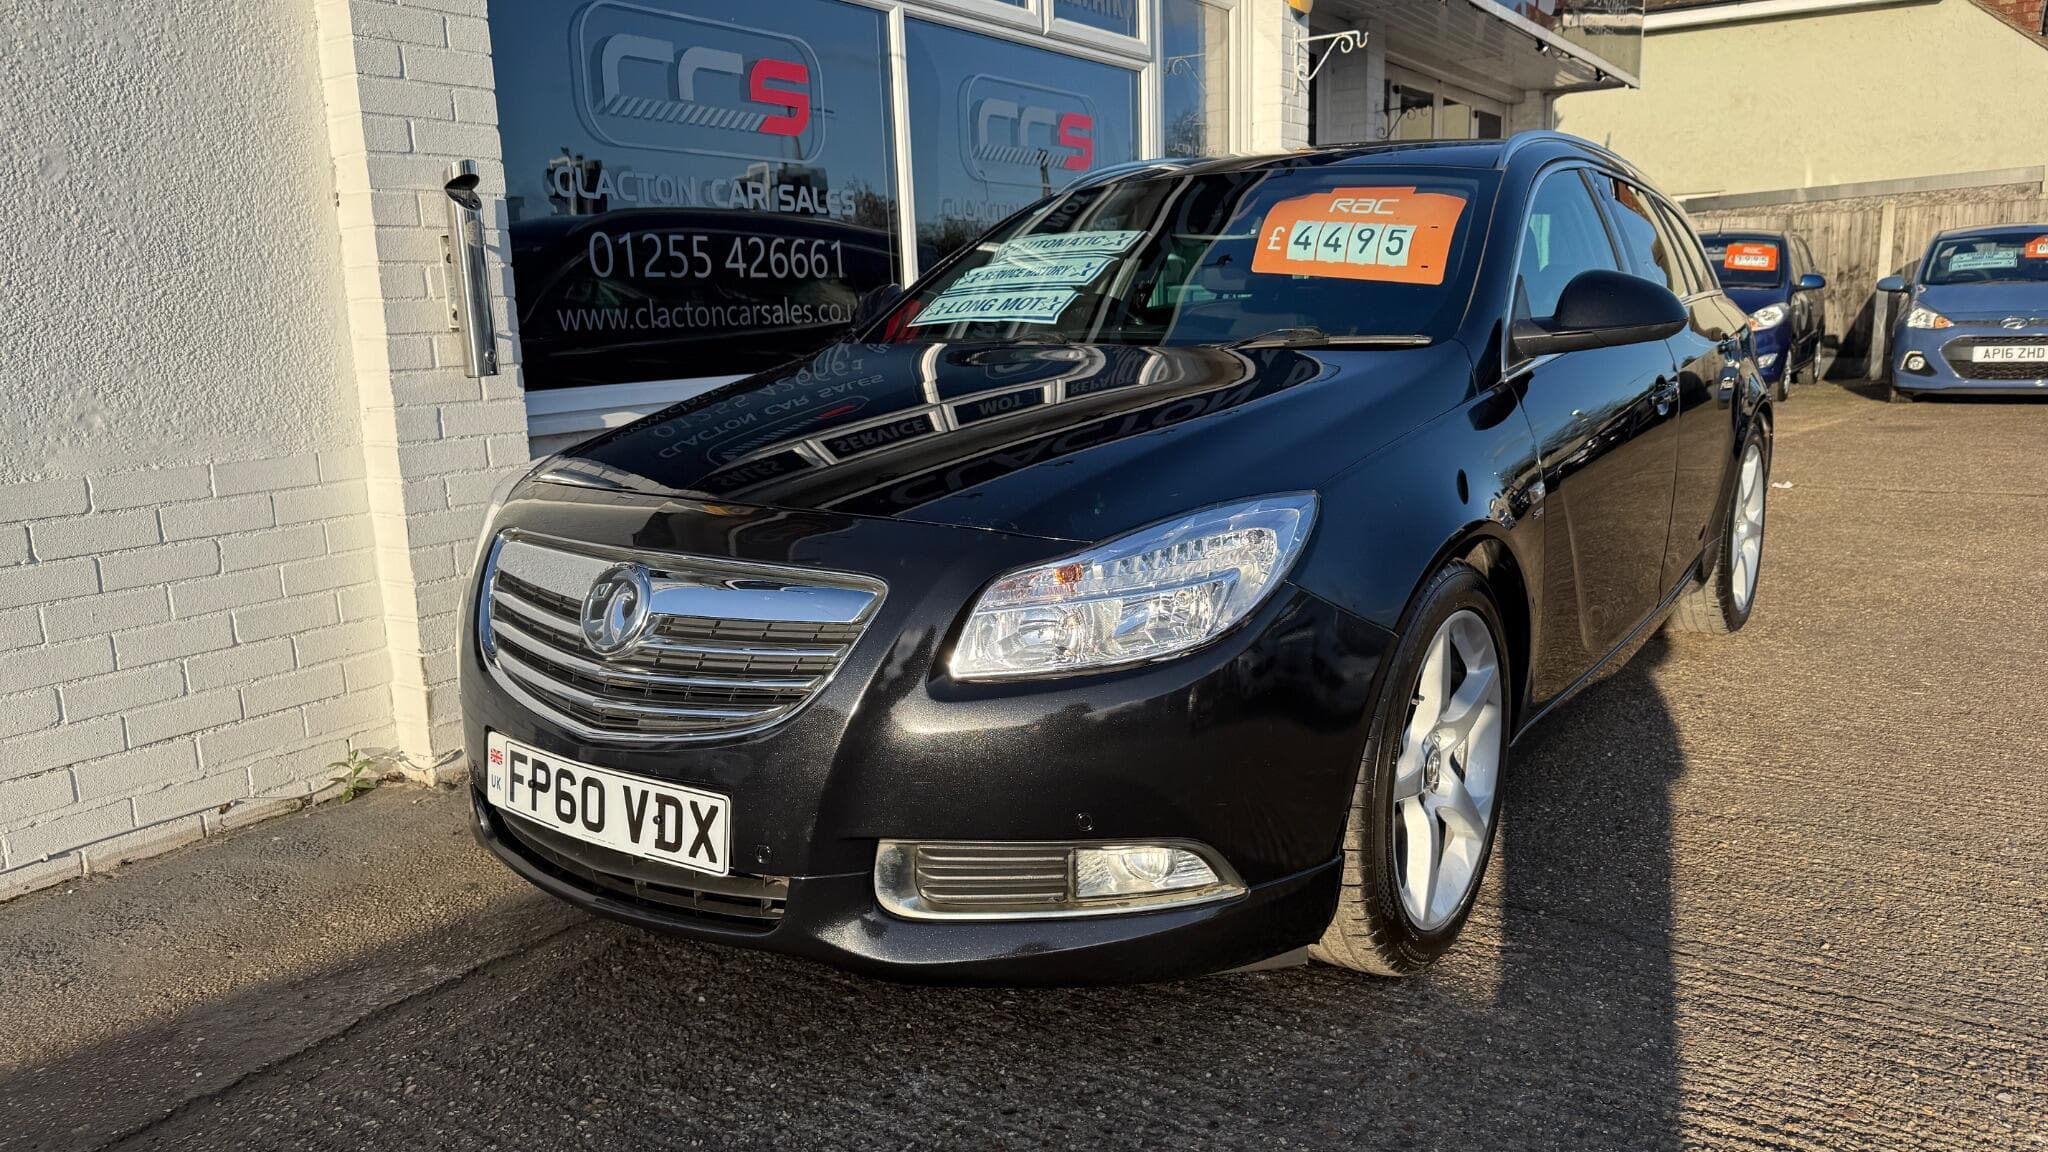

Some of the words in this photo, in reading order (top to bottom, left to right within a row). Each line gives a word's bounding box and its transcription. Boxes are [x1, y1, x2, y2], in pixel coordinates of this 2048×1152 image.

[601, 33, 809, 136] CCS
[977, 98, 1093, 170] CCS
[553, 165, 696, 206] CLACTON
[711, 179, 768, 210] CAR
[779, 184, 856, 217] SALES
[589, 231, 711, 279] 01255
[725, 239, 844, 279] 426661
[981, 267, 1025, 281] SERVICE
[1025, 264, 1073, 277] HISTORY
[945, 299, 996, 314] LONG
[997, 297, 1044, 311] MOT
[1984, 347, 2013, 358] AP16
[2018, 347, 2045, 358] ZHD
[491, 774, 502, 791] UK
[510, 750, 605, 833] FP60
[623, 785, 718, 863] VDX
